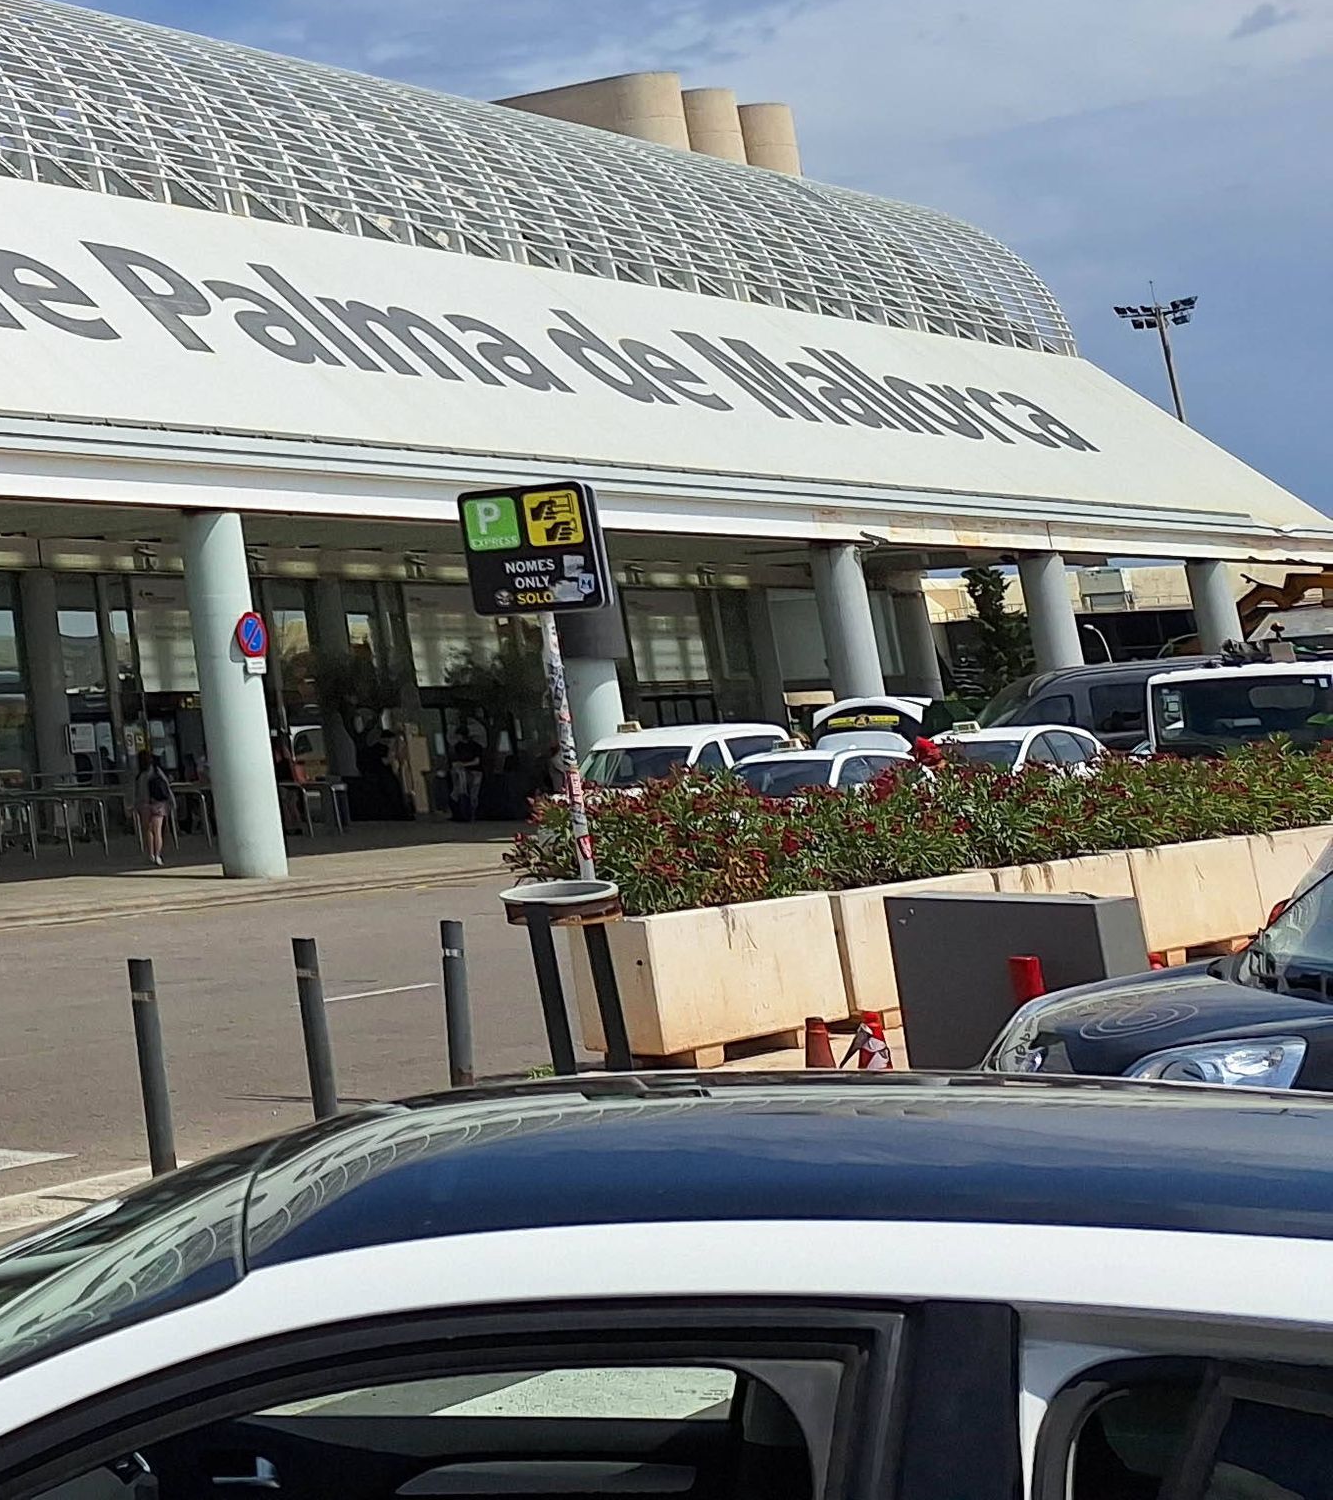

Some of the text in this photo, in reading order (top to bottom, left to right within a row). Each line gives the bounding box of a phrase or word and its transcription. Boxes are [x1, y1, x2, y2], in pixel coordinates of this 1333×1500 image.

[79, 240, 577, 394] Palma
[546, 308, 735, 412] de
[670, 329, 1102, 453] Mallorca
[470, 536, 519, 550] EXPRESS
[514, 575, 550, 589] ONLY
[516, 591, 554, 605] SOLO
